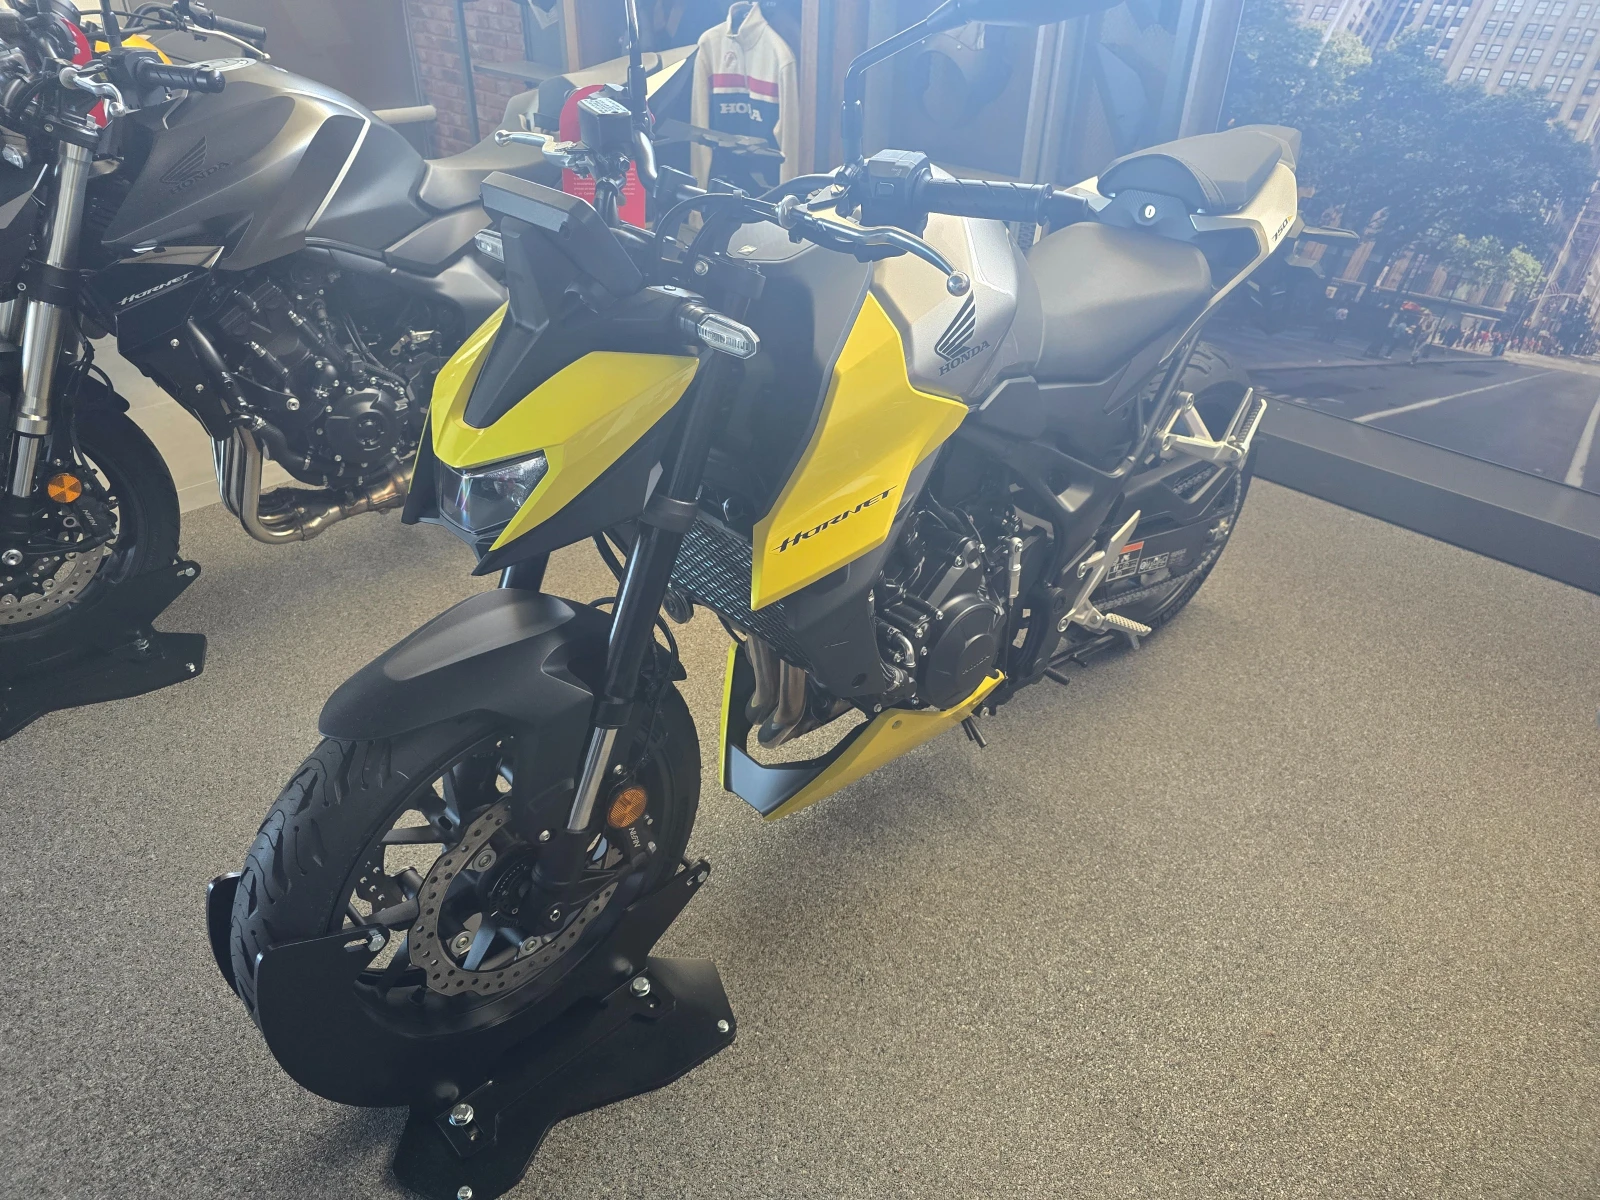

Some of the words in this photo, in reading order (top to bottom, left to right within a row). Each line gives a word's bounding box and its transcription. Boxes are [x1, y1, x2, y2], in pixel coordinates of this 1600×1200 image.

[170, 161, 230, 195] HONDA
[1271, 218, 1289, 242] 750
[116, 271, 194, 306] HORNET
[939, 340, 991, 377] HONDA
[771, 485, 898, 553] HORNET
